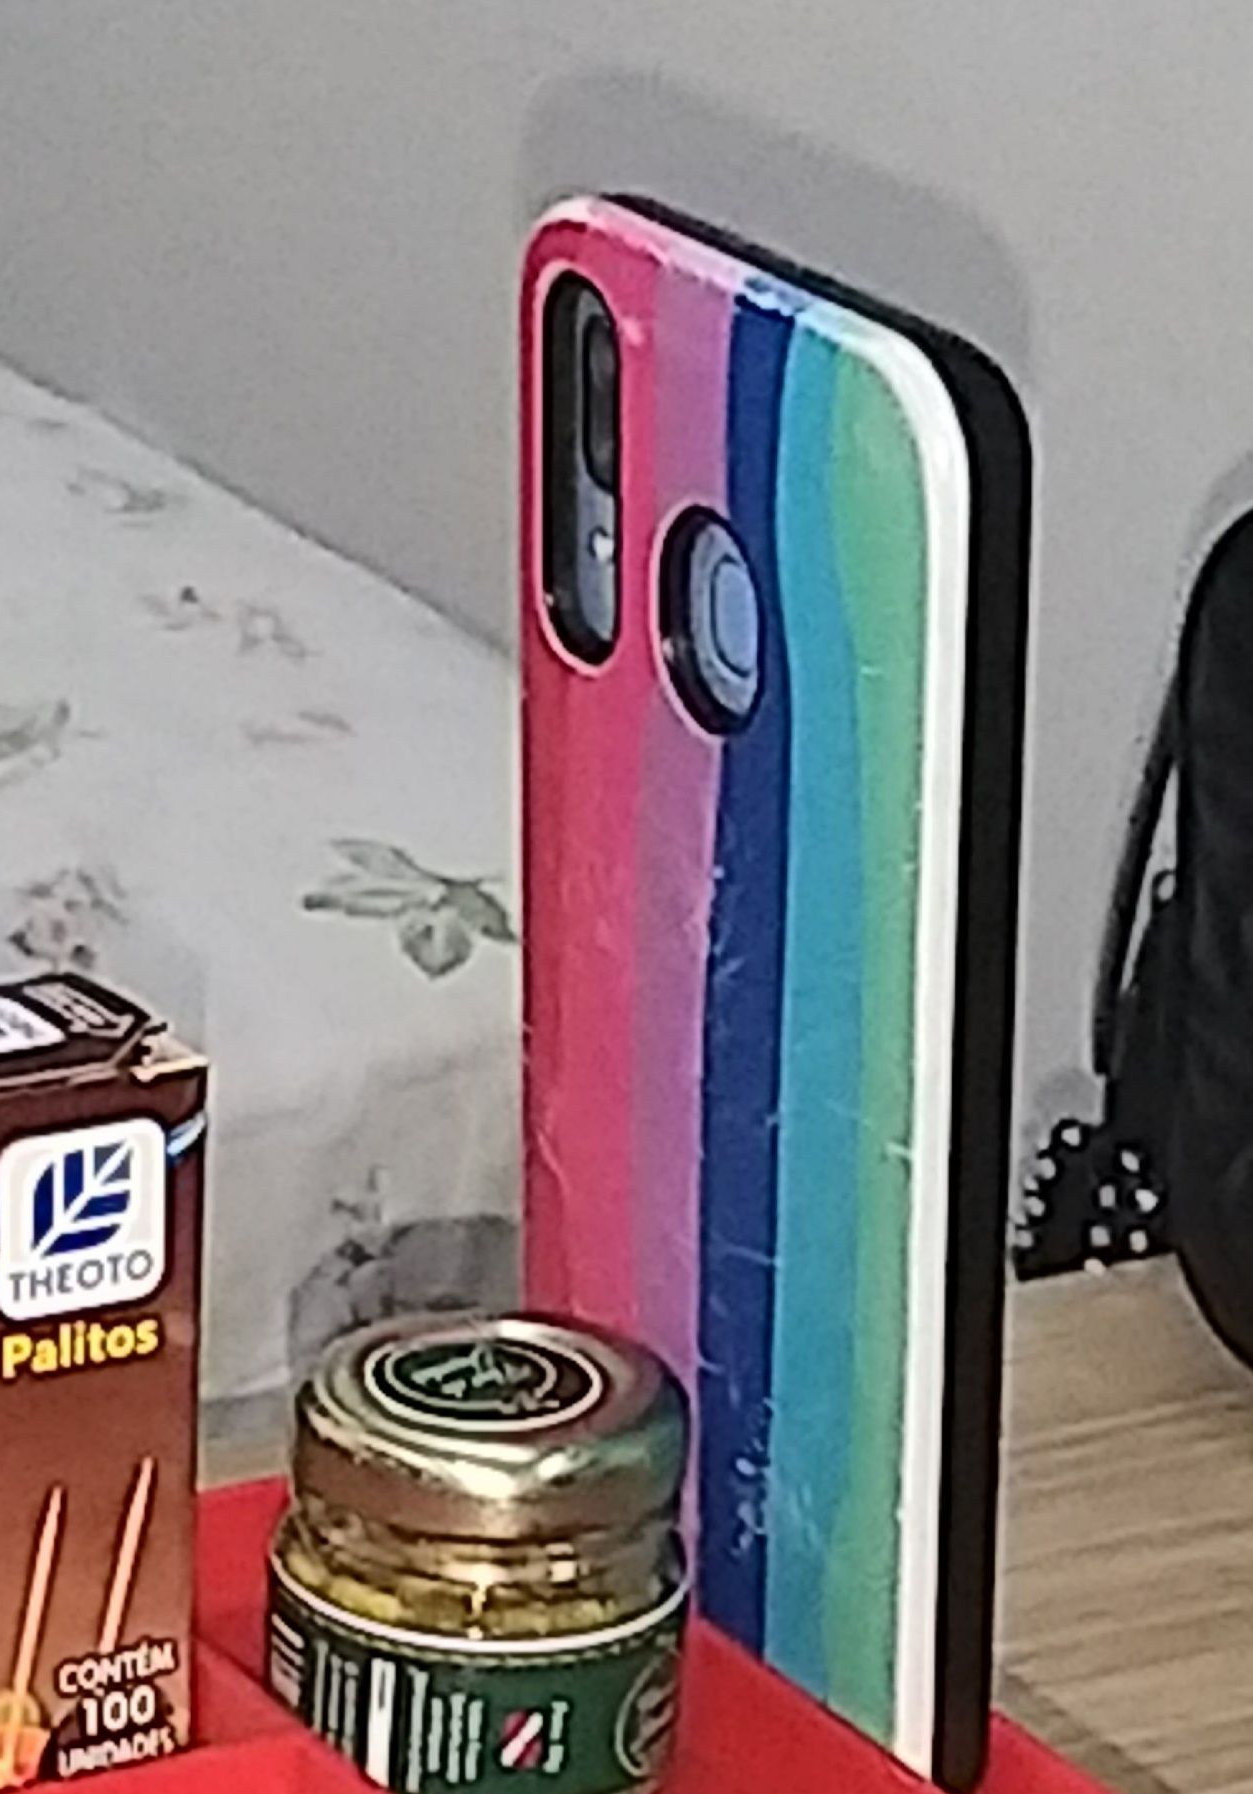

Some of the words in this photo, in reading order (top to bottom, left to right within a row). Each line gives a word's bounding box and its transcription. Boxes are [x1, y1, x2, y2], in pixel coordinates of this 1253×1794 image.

[8, 1249, 154, 1304] THEOTO
[1, 1319, 160, 1380] Palitos
[58, 1640, 176, 1694] CONTÉM
[82, 1683, 156, 1737] 100
[57, 1725, 175, 1777] UNIDADES
